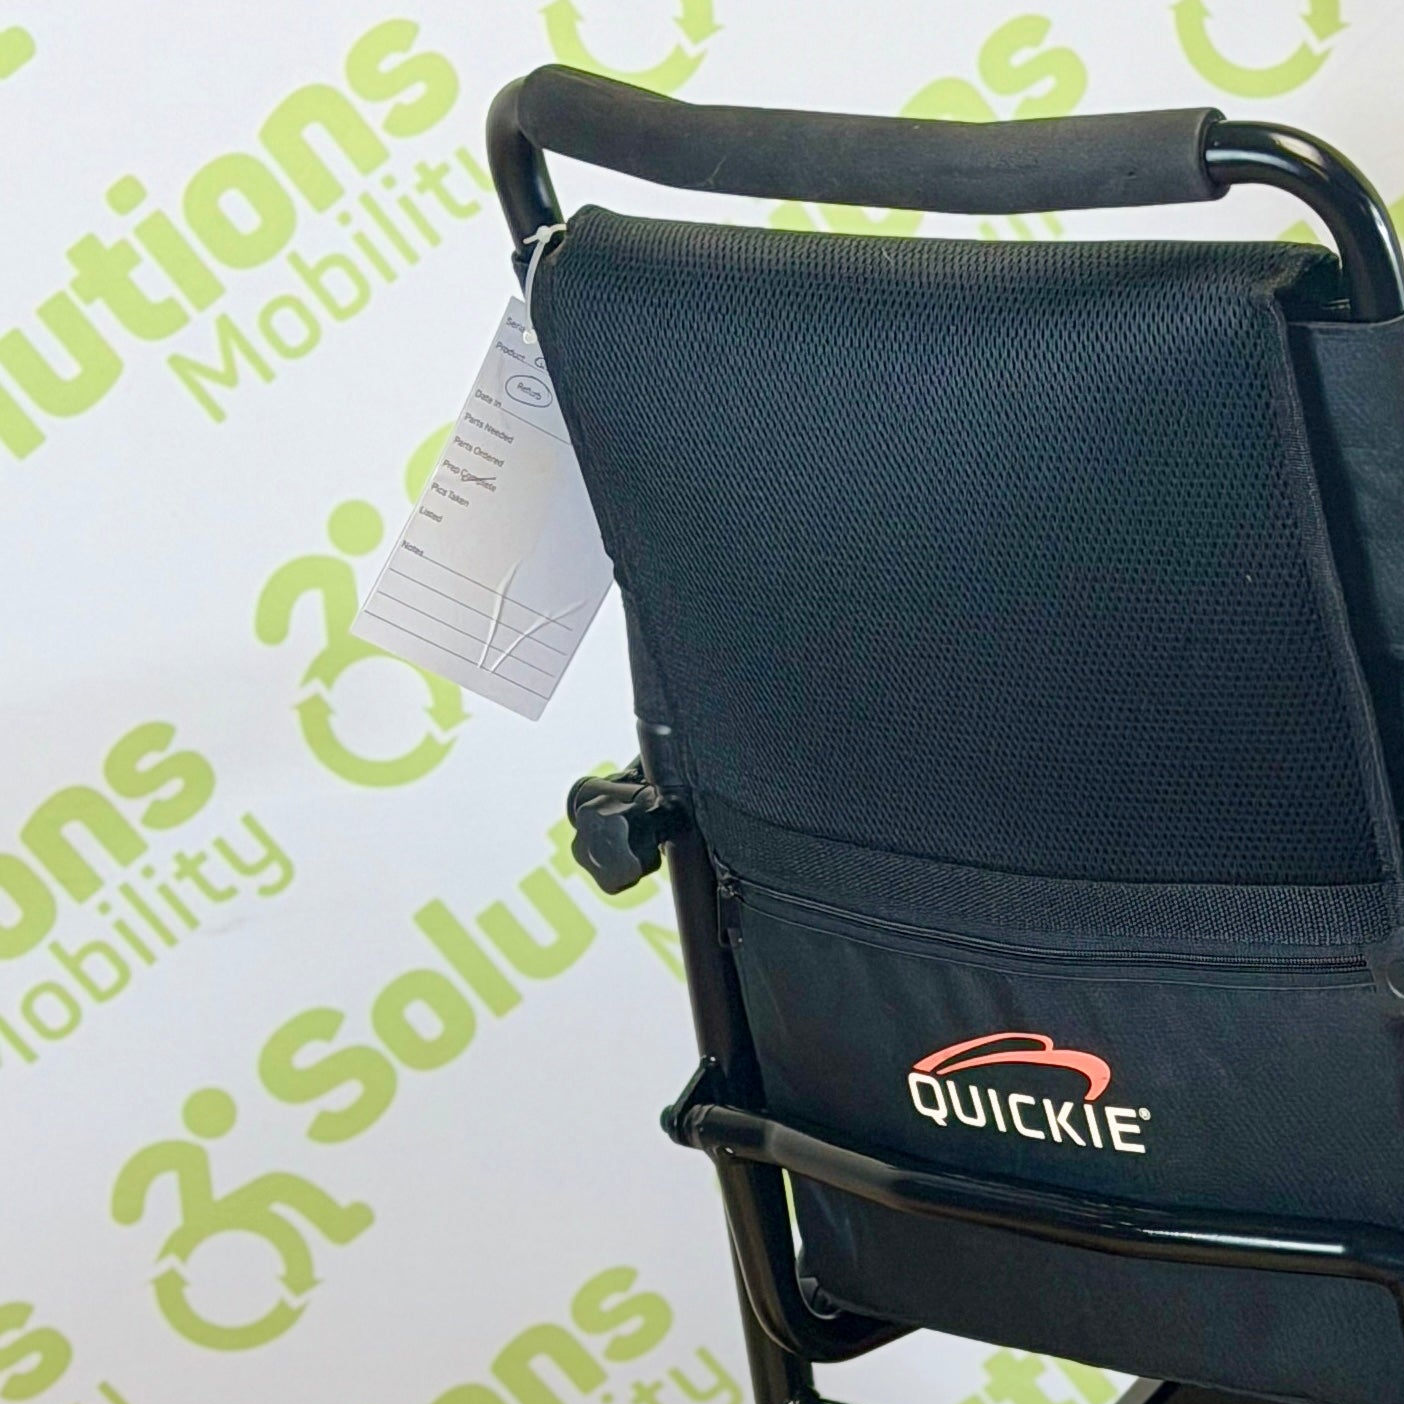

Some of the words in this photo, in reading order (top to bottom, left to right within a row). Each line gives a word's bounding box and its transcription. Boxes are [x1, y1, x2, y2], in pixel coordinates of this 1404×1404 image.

[465, 413, 483, 429] Parts
[484, 422, 514, 444] Needed
[454, 436, 473, 452] Parts
[474, 447, 504, 468] Ordered
[419, 506, 443, 523] Listed
[402, 540, 424, 557] Notes
[908, 1072, 1147, 1154] QUICKIE
